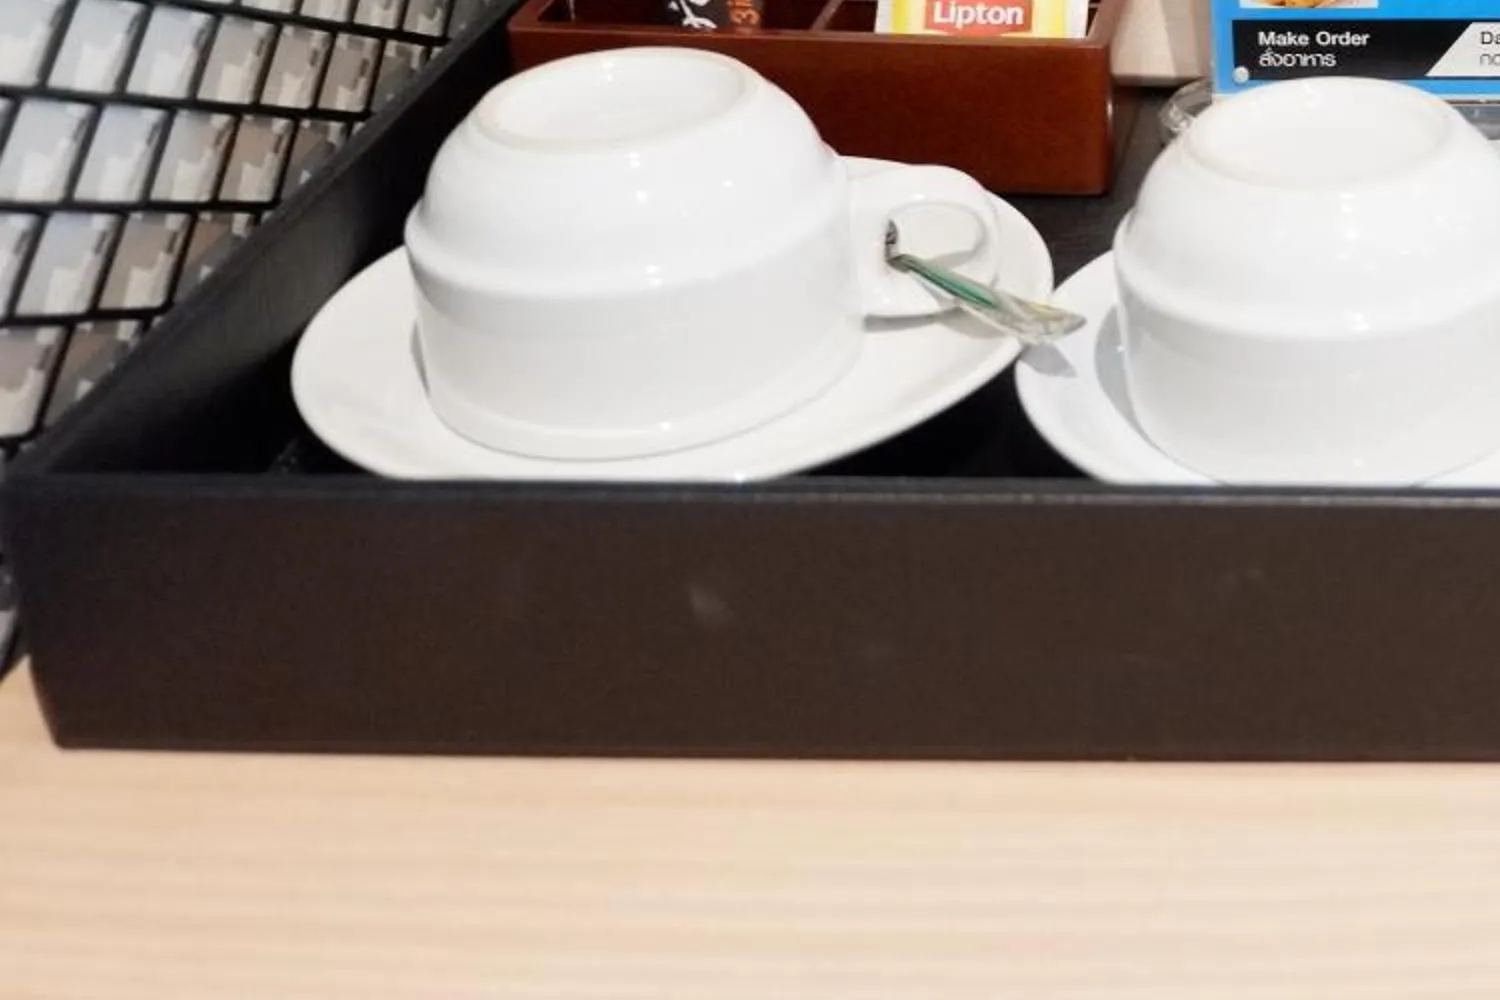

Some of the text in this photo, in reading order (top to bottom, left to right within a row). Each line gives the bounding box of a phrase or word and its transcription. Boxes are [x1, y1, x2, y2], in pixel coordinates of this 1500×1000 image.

[933, 0, 1024, 29] Lipton
[1258, 31, 1370, 46] Make Order
[1259, 47, 1337, 67] สั่งอาหาร
